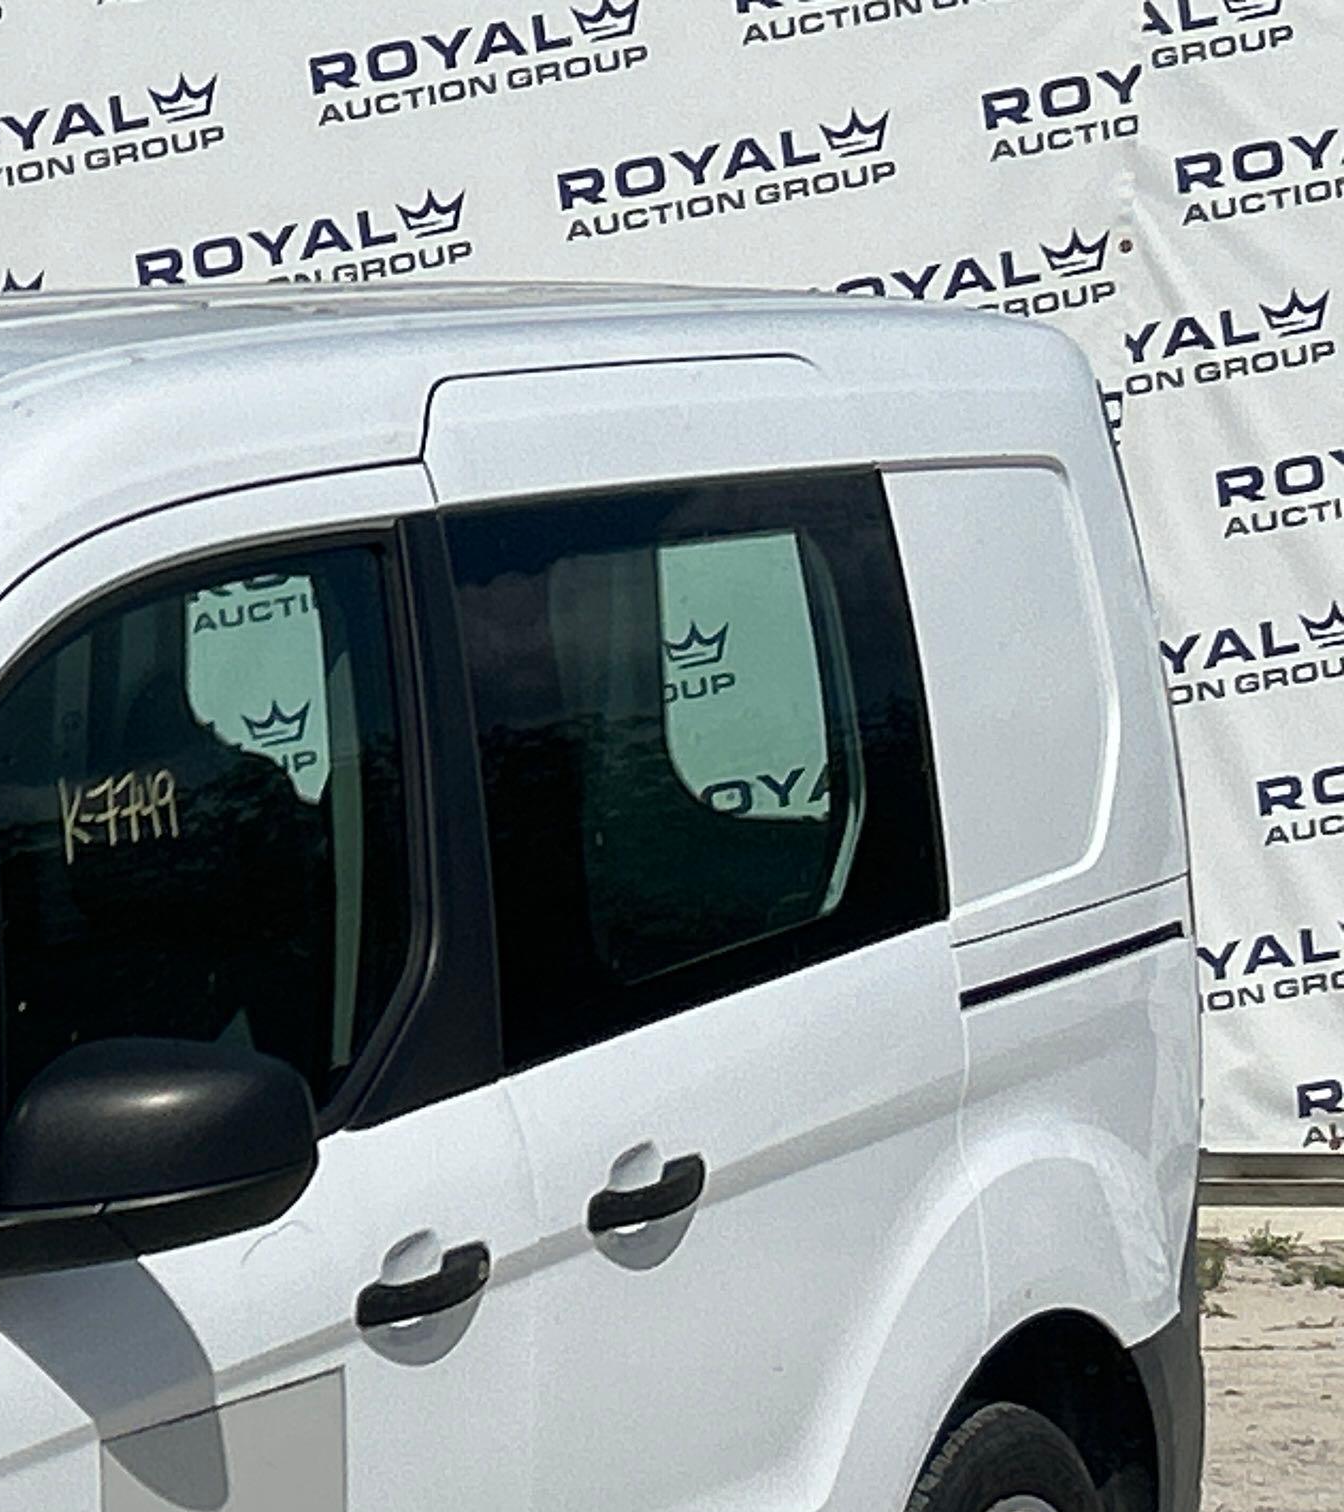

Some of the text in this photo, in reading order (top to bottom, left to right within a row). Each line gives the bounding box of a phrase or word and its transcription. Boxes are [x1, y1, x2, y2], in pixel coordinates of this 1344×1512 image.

[742, 0, 923, 46] AUCTION
[1151, 25, 1294, 69] GROUP
[309, 14, 573, 96] ROYAL
[319, 47, 648, 126] AUCTION GROUP
[981, 64, 1143, 130] ROY
[84, 128, 224, 171] GROUP
[990, 115, 1140, 162] AUCTIO
[1174, 128, 1342, 194] ROY
[557, 130, 821, 211] ROYAL
[566, 162, 896, 241] AUCTION GROUP
[1181, 177, 1344, 227] AUCTIO
[135, 210, 398, 284] ROYAL
[333, 241, 472, 284] GROUP
[978, 280, 1117, 318] ROUP
[1124, 309, 1260, 364] YAL
[1193, 340, 1336, 385] GROUP
[1224, 498, 1343, 540] AUCTI
[193, 593, 310, 634] AUCTI
[1158, 621, 1301, 675] YAL
[663, 672, 737, 704] OUP
[1234, 656, 1344, 696] GROU
[1195, 928, 1341, 981] YAL
